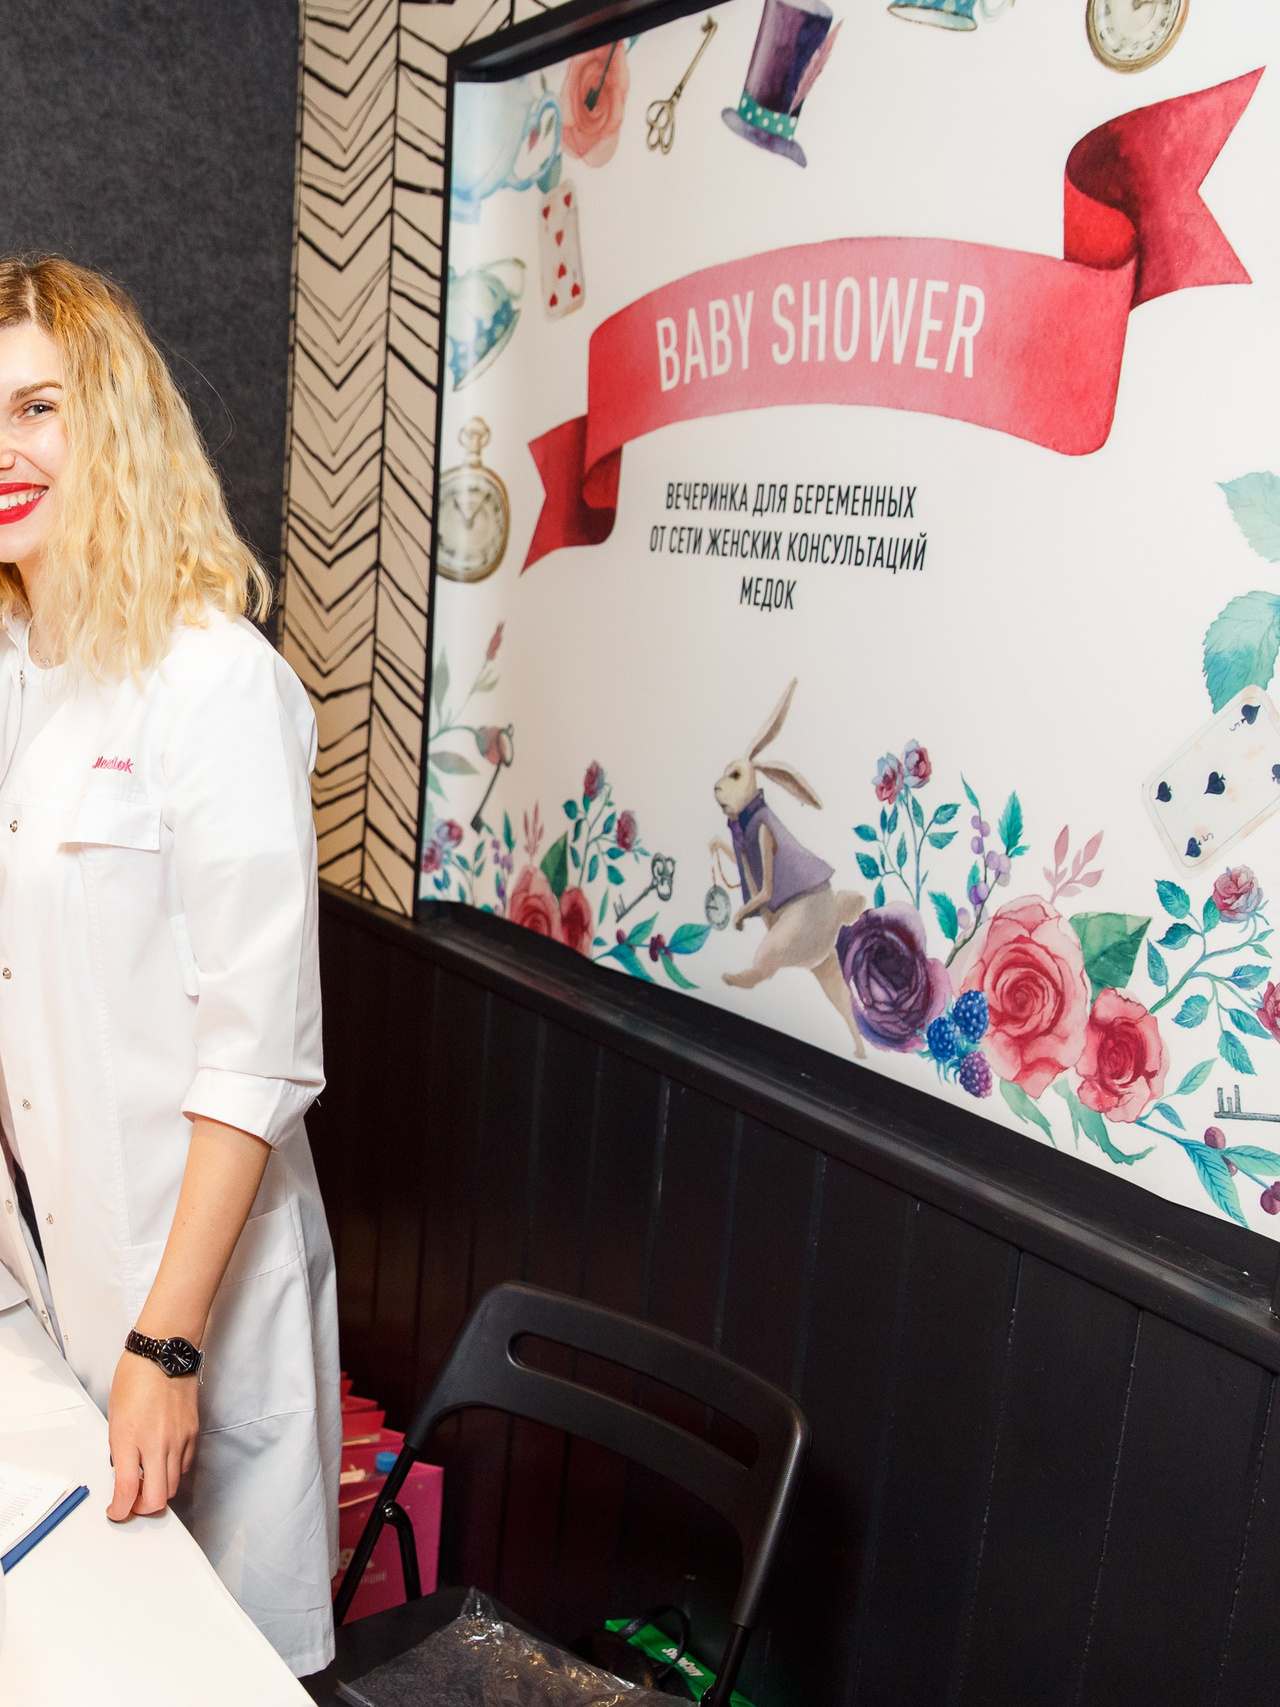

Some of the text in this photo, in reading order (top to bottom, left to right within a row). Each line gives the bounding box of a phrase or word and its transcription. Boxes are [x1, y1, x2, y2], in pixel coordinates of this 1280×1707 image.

[656, 276, 985, 392] BABY SHOWER
[665, 482, 917, 518] ВЕЧЕРИНКА ДЛЯ БЕРЕМЕННЫХ
[649, 525, 927, 574] ОТ СЕТИ ЖЕНСКИХ КОНСУЛЬТАЦИЙ
[739, 576, 797, 612] МЕДОК
